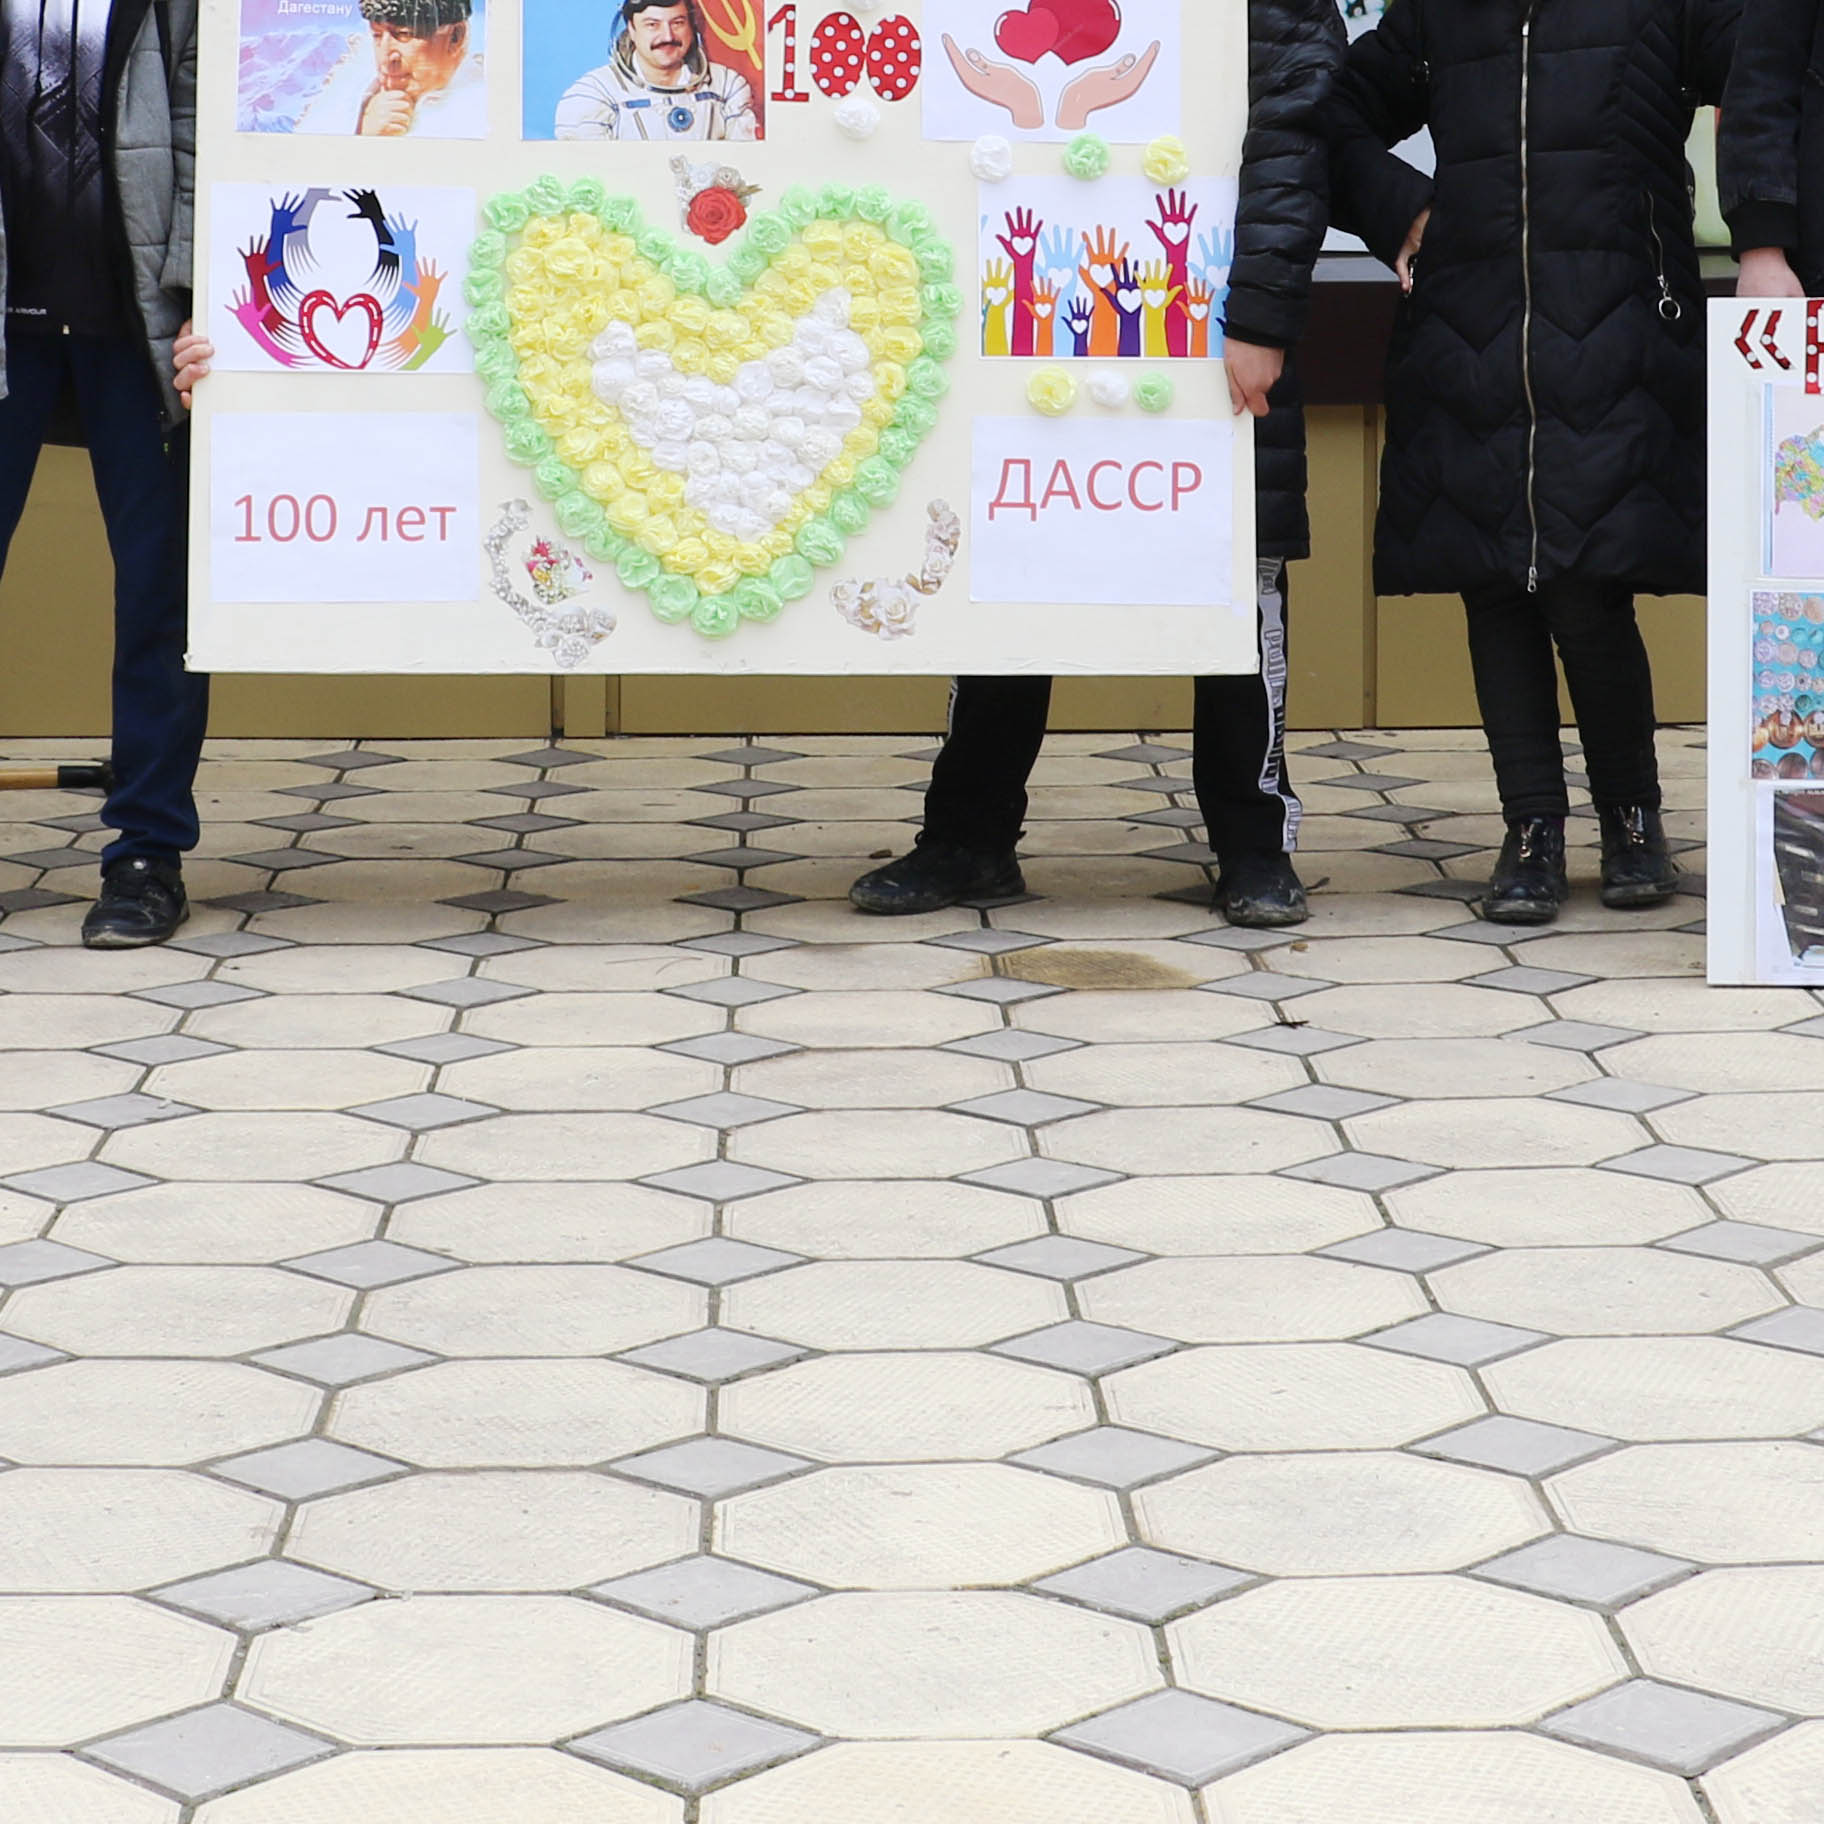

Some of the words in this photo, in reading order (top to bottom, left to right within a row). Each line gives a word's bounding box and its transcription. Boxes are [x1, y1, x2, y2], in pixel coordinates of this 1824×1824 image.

[277, 0, 353, 17] Дагестану
[766, 2, 922, 102] 100
[234, 493, 338, 543] 100
[355, 505, 458, 543] лет
[987, 458, 1203, 522] ДАССР
